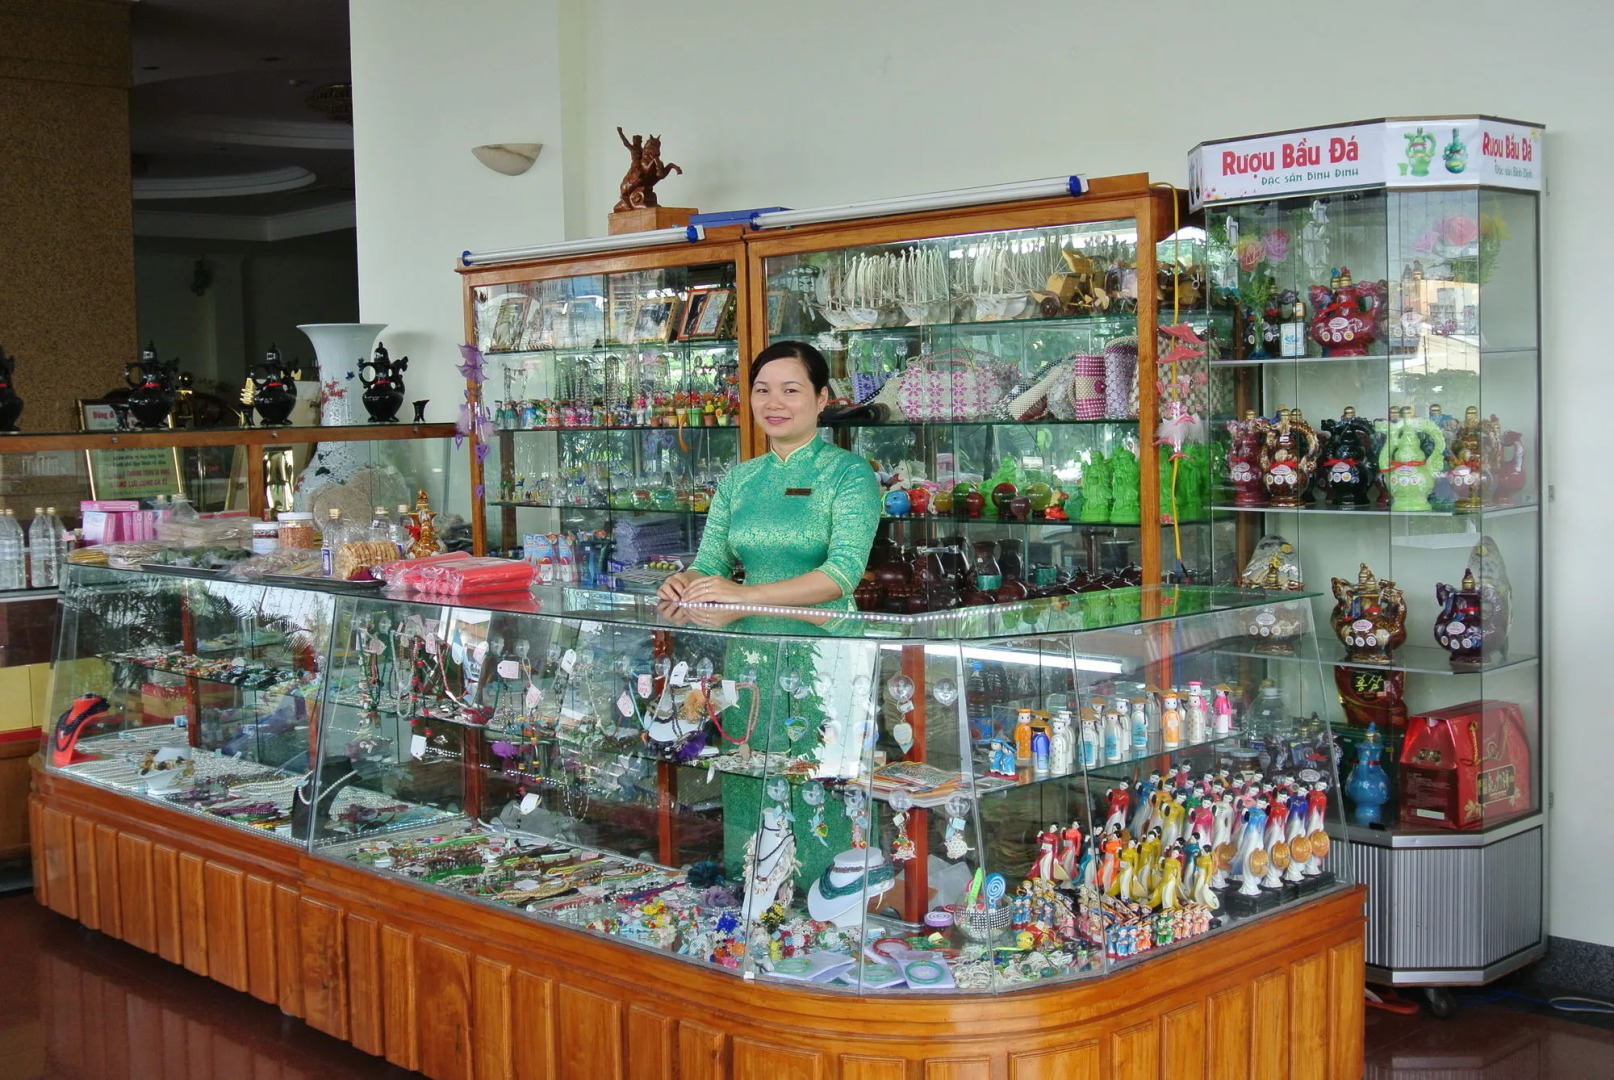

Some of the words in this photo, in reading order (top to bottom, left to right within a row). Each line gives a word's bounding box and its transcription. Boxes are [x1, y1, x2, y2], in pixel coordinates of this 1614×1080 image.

[1222, 151, 1275, 179] Rượu
[1282, 138, 1320, 169] Bầu
[1329, 135, 1359, 163] Đá
[1522, 138, 1532, 162] Đá
